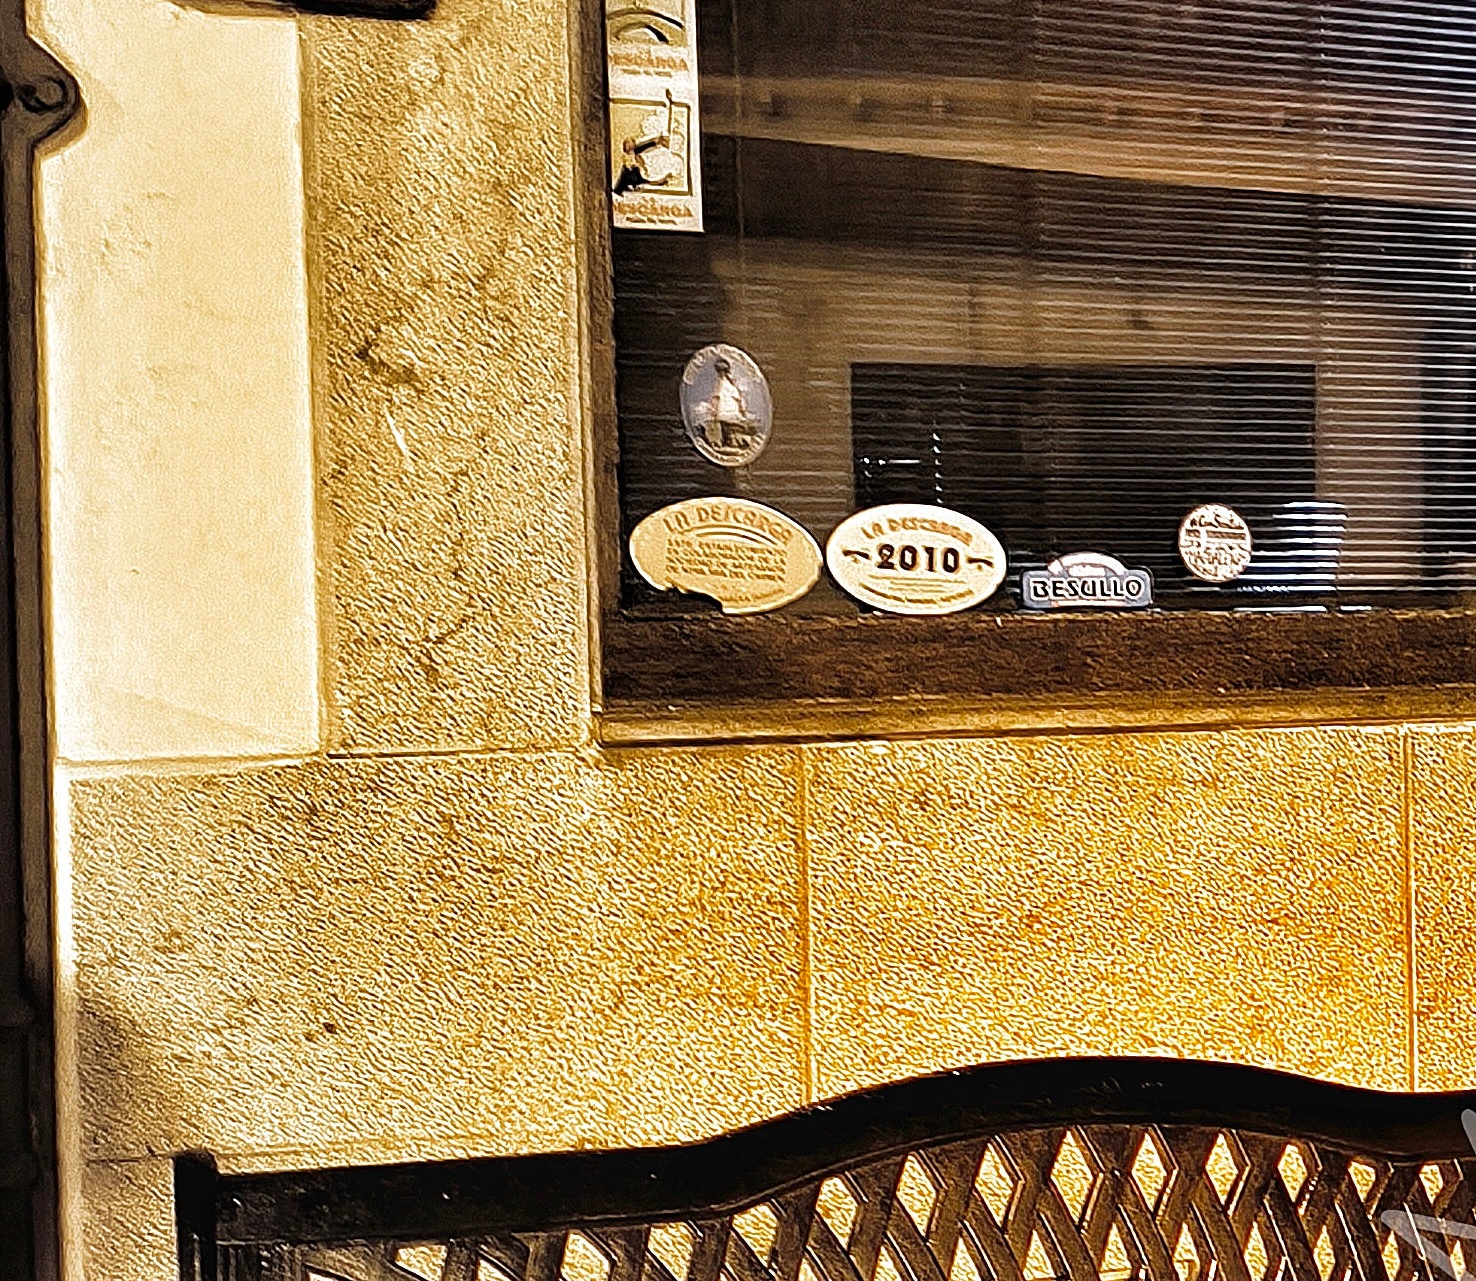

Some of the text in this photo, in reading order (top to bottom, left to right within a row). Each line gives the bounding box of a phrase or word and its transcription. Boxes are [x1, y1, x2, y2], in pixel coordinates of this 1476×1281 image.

[696, 503, 793, 547] DESCARGA
[877, 543, 960, 574] 2010
[1032, 579, 1143, 598] BESULLO
